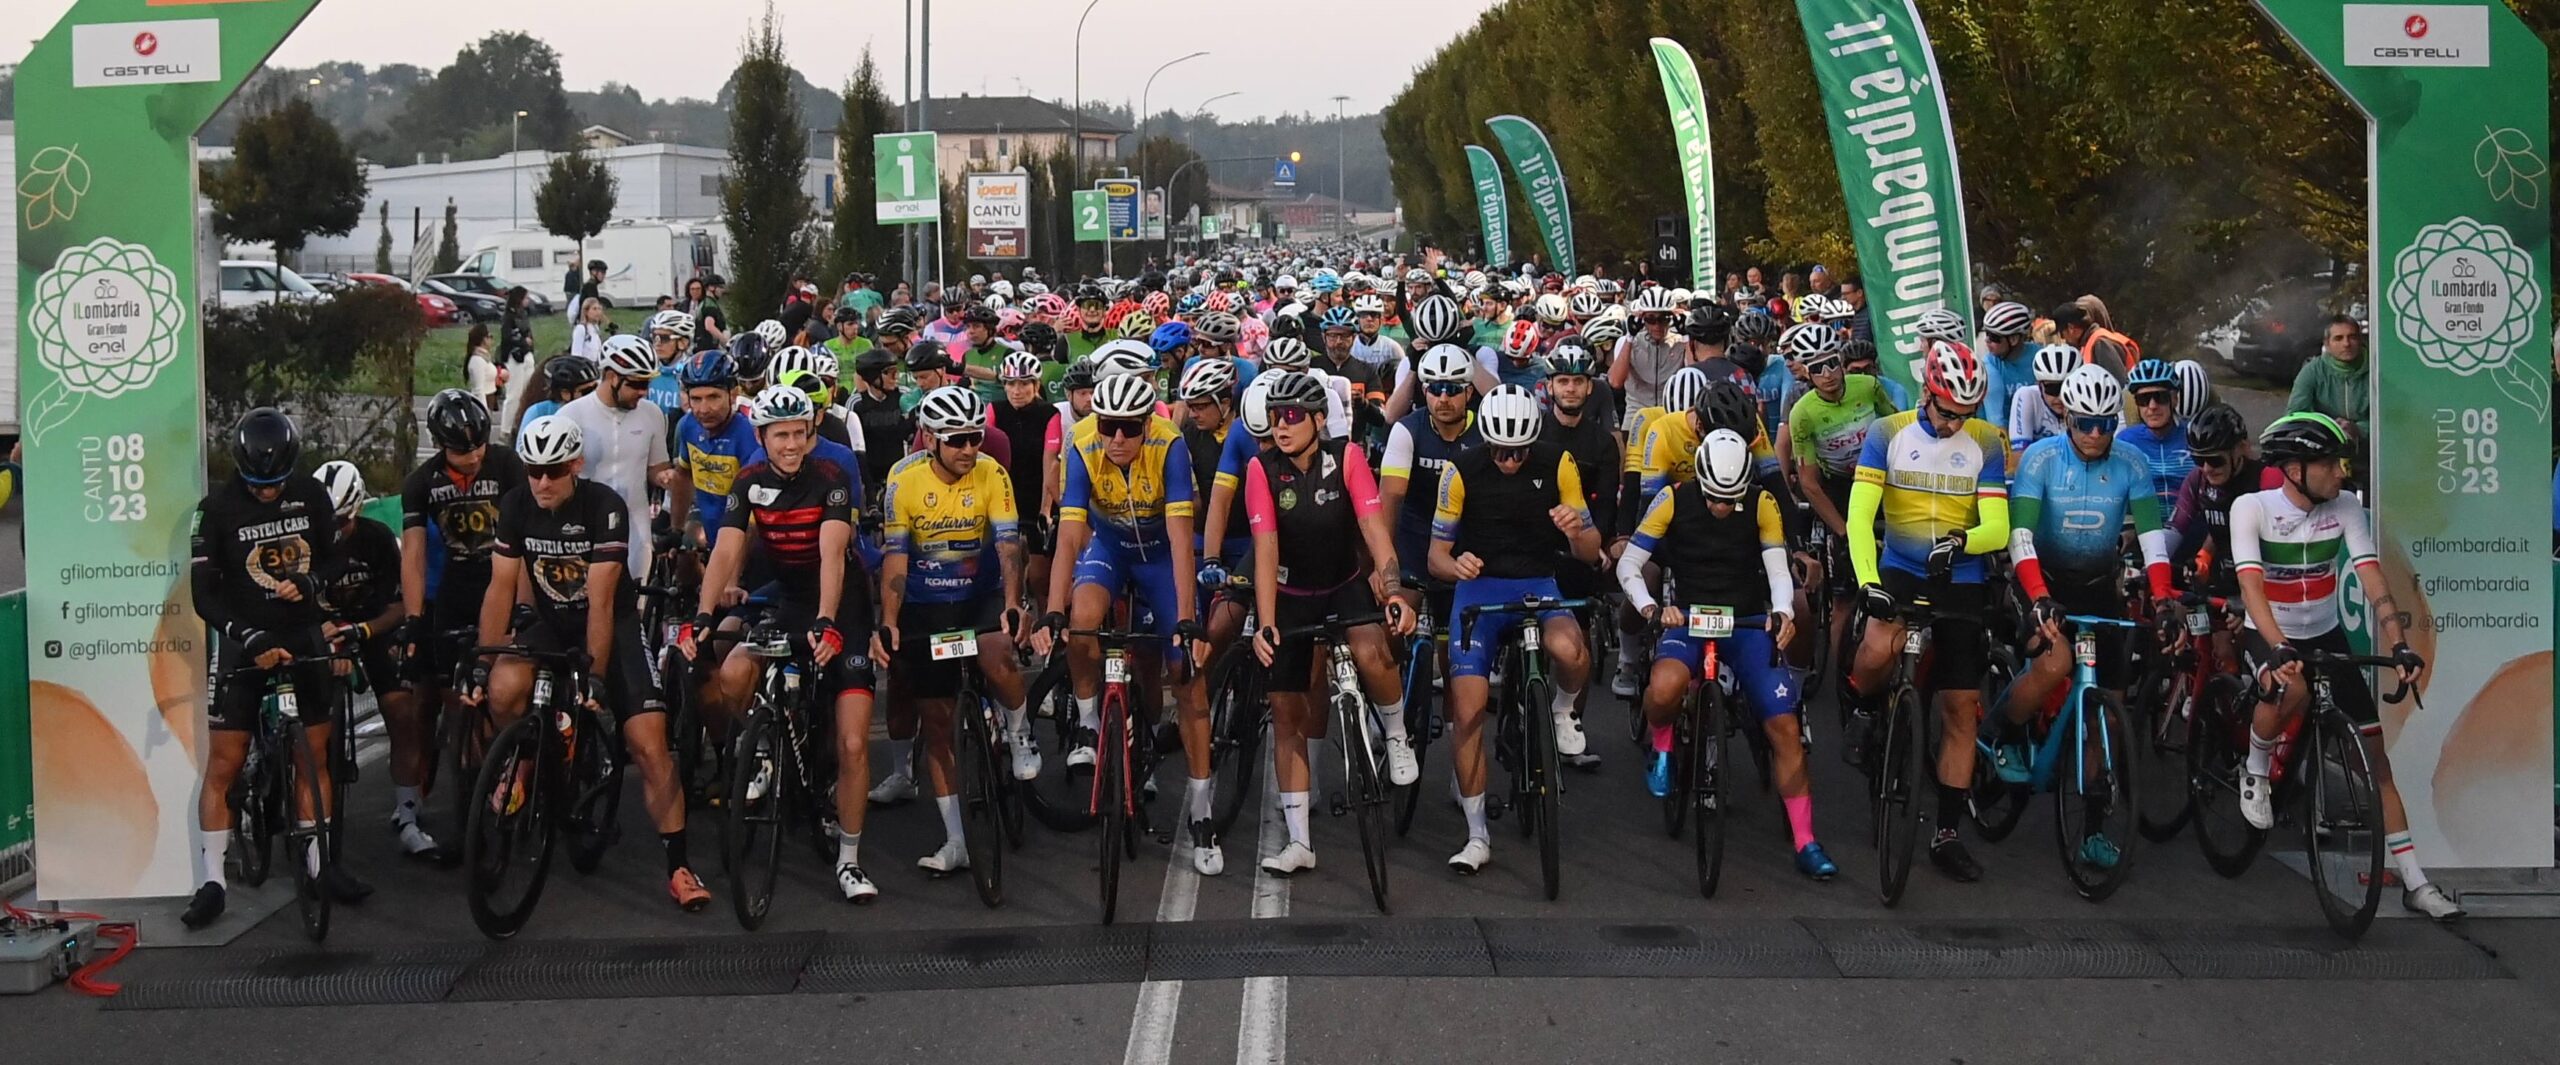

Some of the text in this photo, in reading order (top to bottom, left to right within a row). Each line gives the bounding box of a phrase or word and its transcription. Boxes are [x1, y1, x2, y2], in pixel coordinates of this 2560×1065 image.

[897, 155, 915, 197] 1
[973, 202, 1022, 217] CANTÙ
[1081, 206, 1099, 230] 2
[1206, 222, 1215, 233] 3
[2444, 301, 2484, 314] Gran Fondo
[87, 323, 128, 336] Gran Fondo
[2445, 316, 2483, 332] enel
[88, 338, 126, 354] enel
[2016, 397, 2024, 436] GIANT
[2461, 407, 2498, 435] 08
[107, 434, 145, 462] 08
[2432, 408, 2457, 493] CANTÙ
[2462, 438, 2498, 464] 10
[77, 436, 104, 523] CANTÙ
[108, 465, 145, 491] 10
[2461, 466, 2500, 494] 23
[108, 493, 148, 522] 23
[284, 516, 311, 534] CARS
[2411, 537, 2530, 559] gfilombardia.it
[60, 562, 181, 585] gfilombardia.it
[924, 577, 973, 587] KOMETA
[2425, 575, 2530, 597] gfilombardia
[74, 602, 182, 625] gfilombardia
[2418, 611, 2539, 633] @gfilombardia
[69, 637, 193, 661] @gfilombardia
[951, 642, 965, 656] 80
